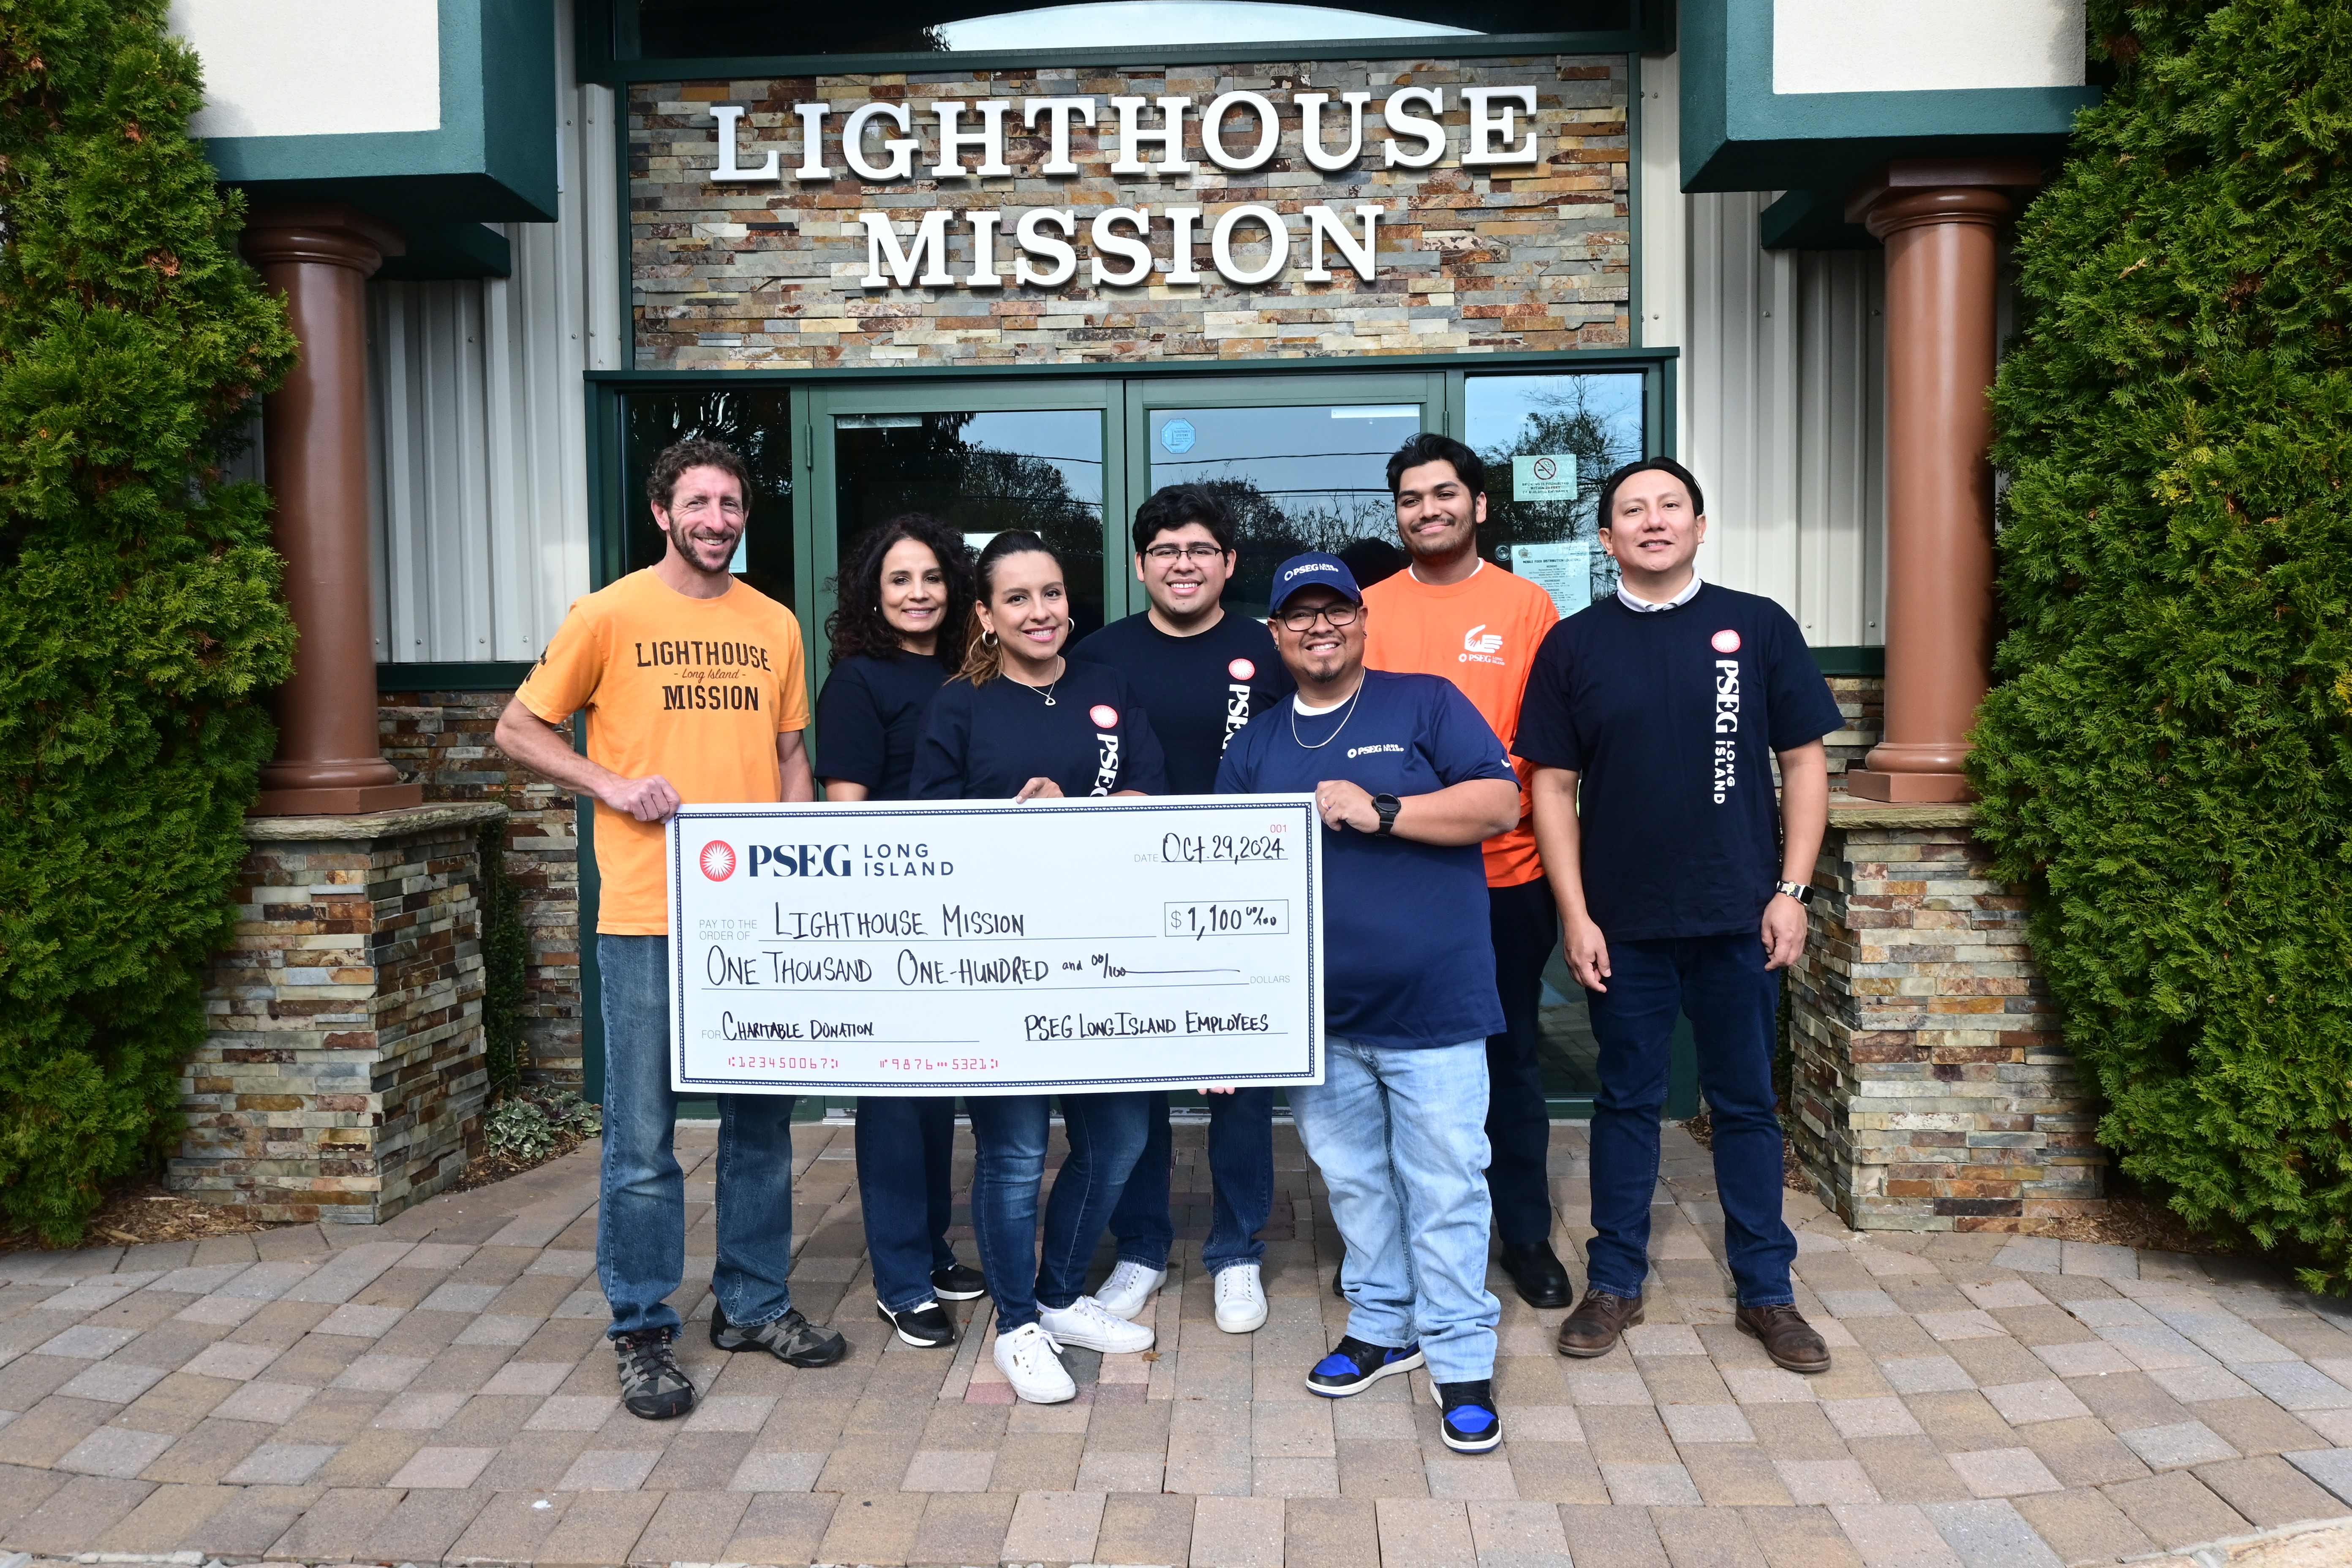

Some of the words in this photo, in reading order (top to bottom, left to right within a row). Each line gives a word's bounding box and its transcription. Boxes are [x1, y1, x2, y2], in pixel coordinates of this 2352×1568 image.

[710, 86, 1539, 183] LIGHTHOUSE
[859, 204, 1384, 290] MISSION
[1293, 564, 1319, 575] PSEG
[635, 641, 771, 672] LIGHTHOUSE
[1468, 653, 1491, 663] PSEG
[682, 668, 705, 683] Long
[708, 669, 740, 679] Island
[662, 685, 758, 711] MISSION
[1715, 660, 1740, 733] PSEG
[1358, 745, 1382, 755] PSEG
[1714, 740, 1726, 804] ISLAND
[1726, 740, 1735, 787] LONG
[1270, 824, 1287, 833] 001
[749, 844, 852, 877] PSEG
[864, 844, 929, 858] LONG
[1134, 854, 1159, 862] DATE
[865, 861, 954, 877] ISLAND
[699, 920, 718, 929] PAY
[721, 920, 735, 929] TO
[738, 919, 757, 929] THE
[775, 902, 928, 939] LIGHTHOUSE
[942, 904, 1024, 937] MISSION
[700, 931, 734, 941] ORDER
[737, 931, 750, 940] OF
[707, 945, 760, 986] ONE
[762, 951, 872, 984] THOUSAND
[898, 949, 1049, 986] ONE-HUNDRED
[1062, 960, 1083, 971] and
[1250, 975, 1290, 984] DOLLARS
[702, 1030, 721, 1039] FOR
[722, 1011, 804, 1041] CHARITABLE
[810, 1020, 874, 1040] DONATION
[1025, 1015, 1073, 1041] PSEG
[1186, 1010, 1269, 1034] EMPLOYEES
